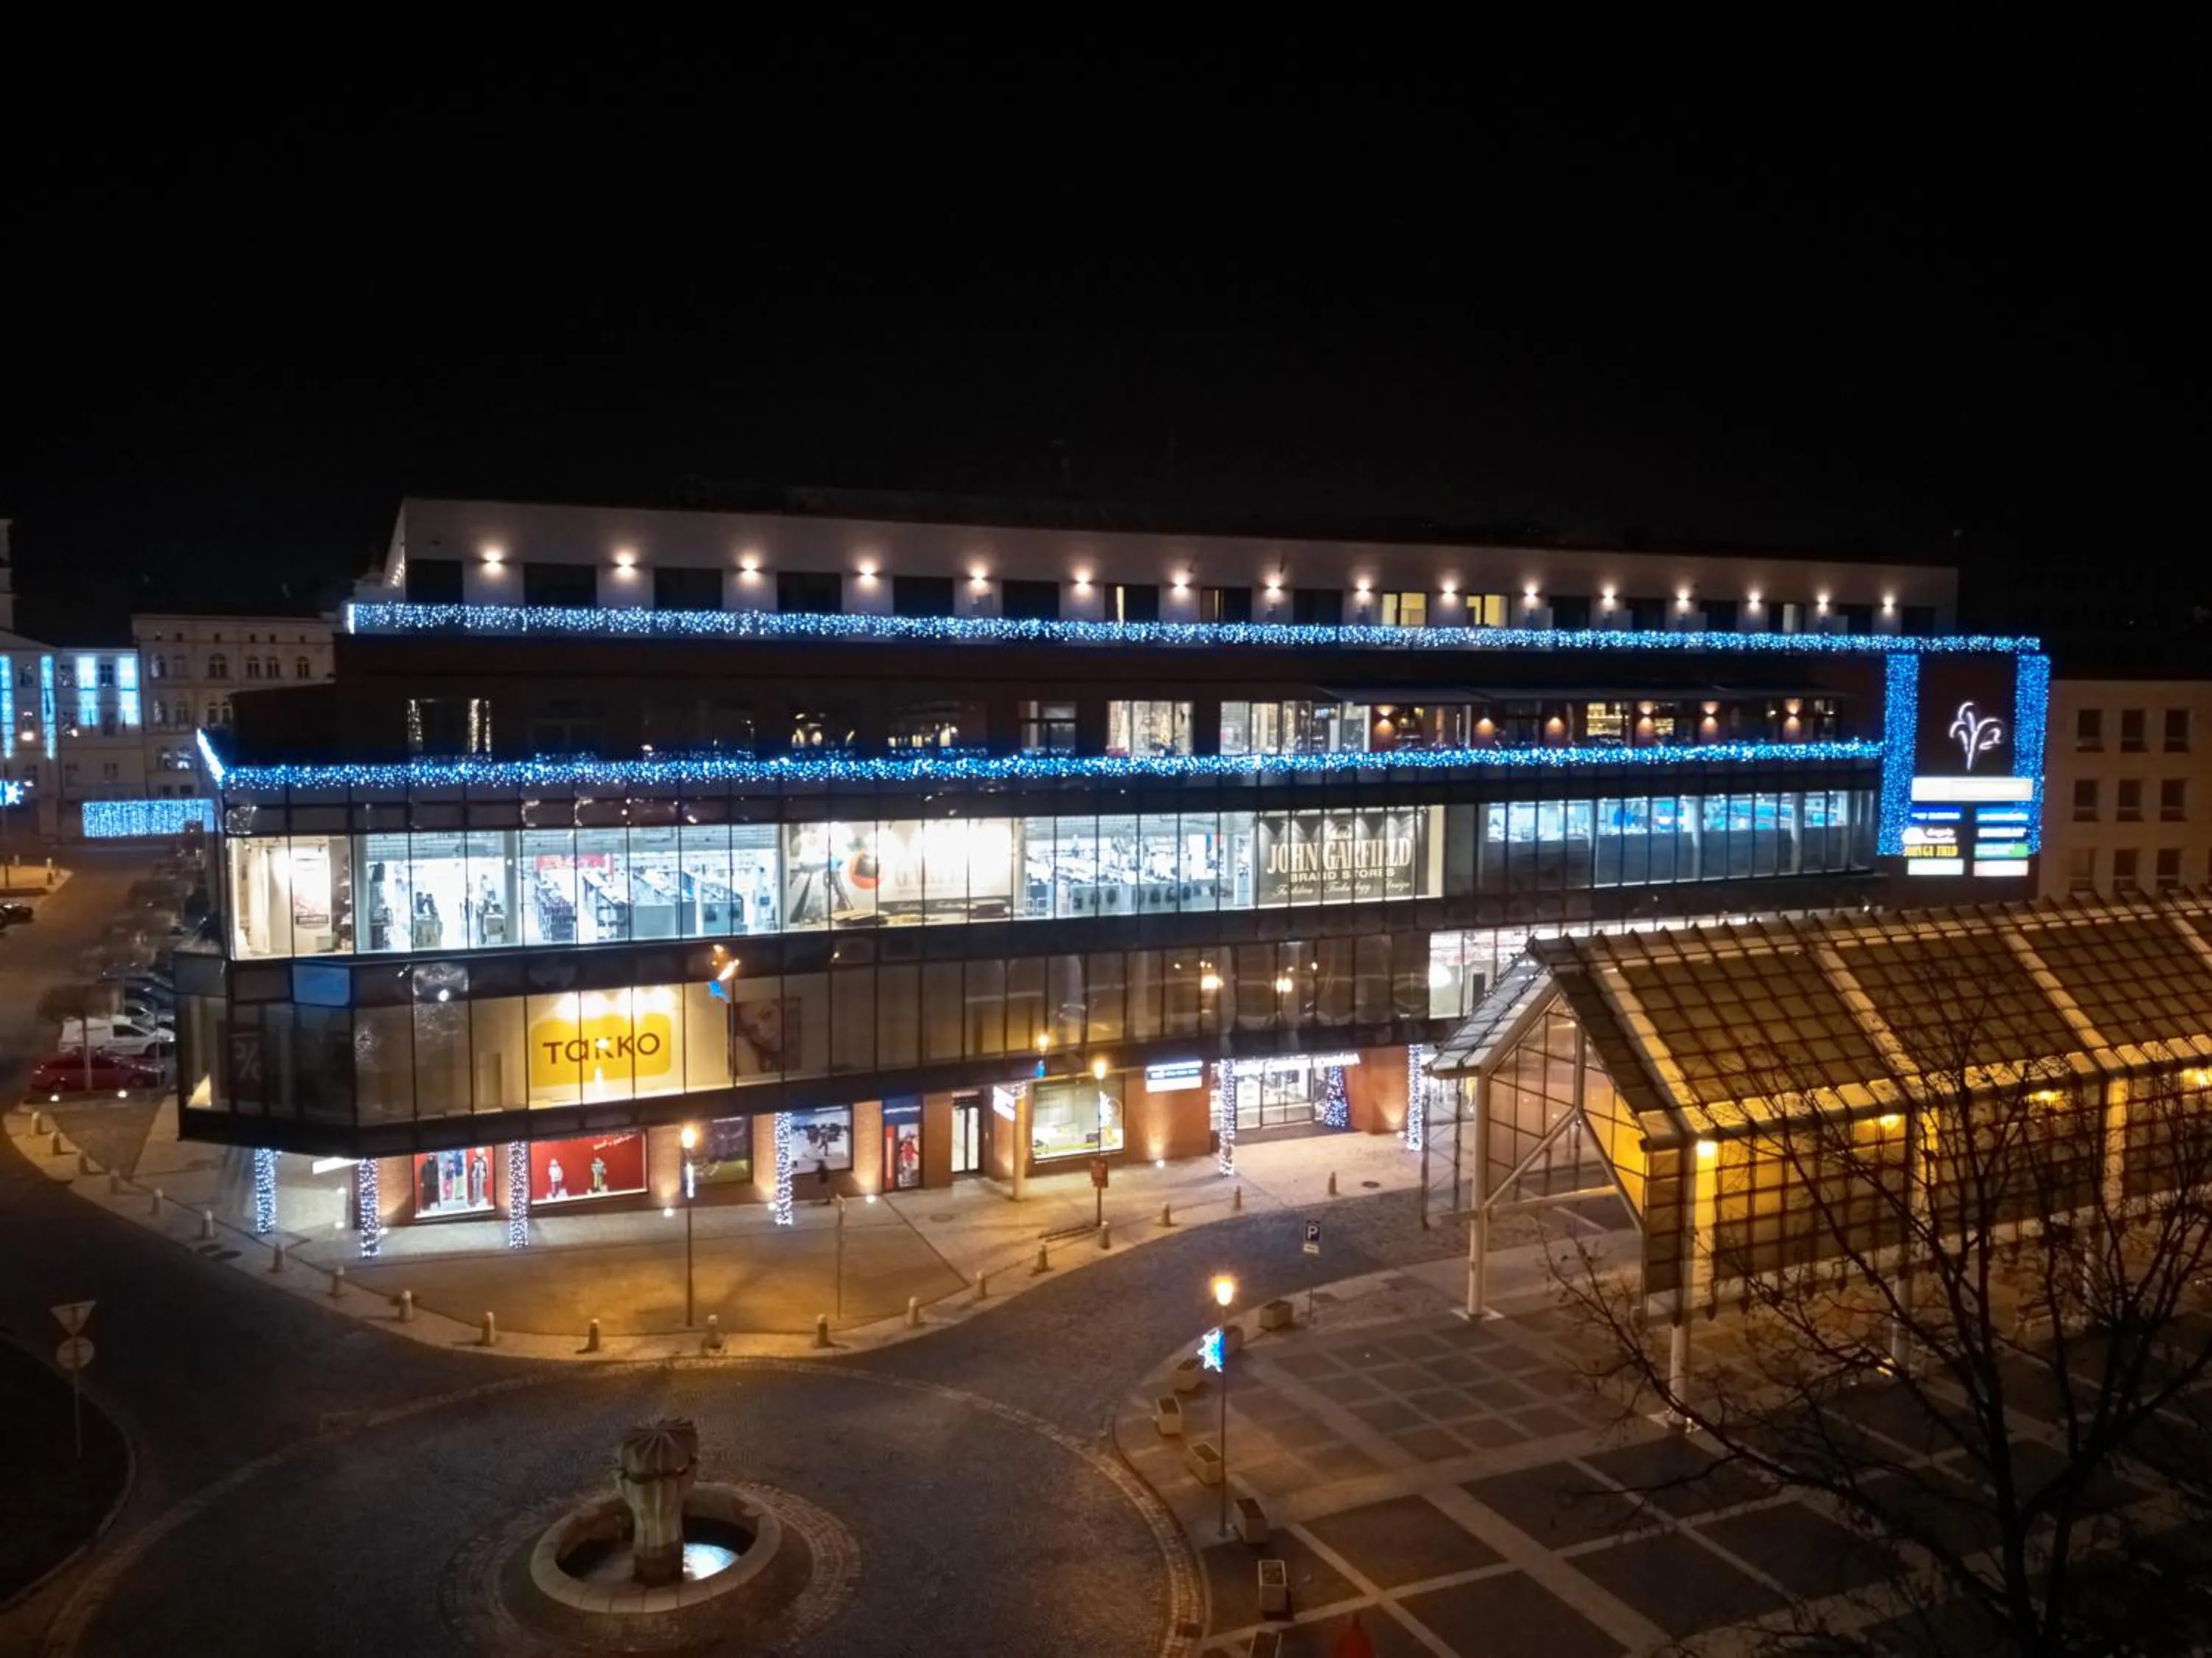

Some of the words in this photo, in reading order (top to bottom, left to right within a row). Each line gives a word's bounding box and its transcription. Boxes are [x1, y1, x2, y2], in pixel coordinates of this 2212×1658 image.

[1267, 843, 1319, 873] JOHN
[1290, 871, 1337, 883] BRAND
[1307, 1225, 1318, 1240] P
